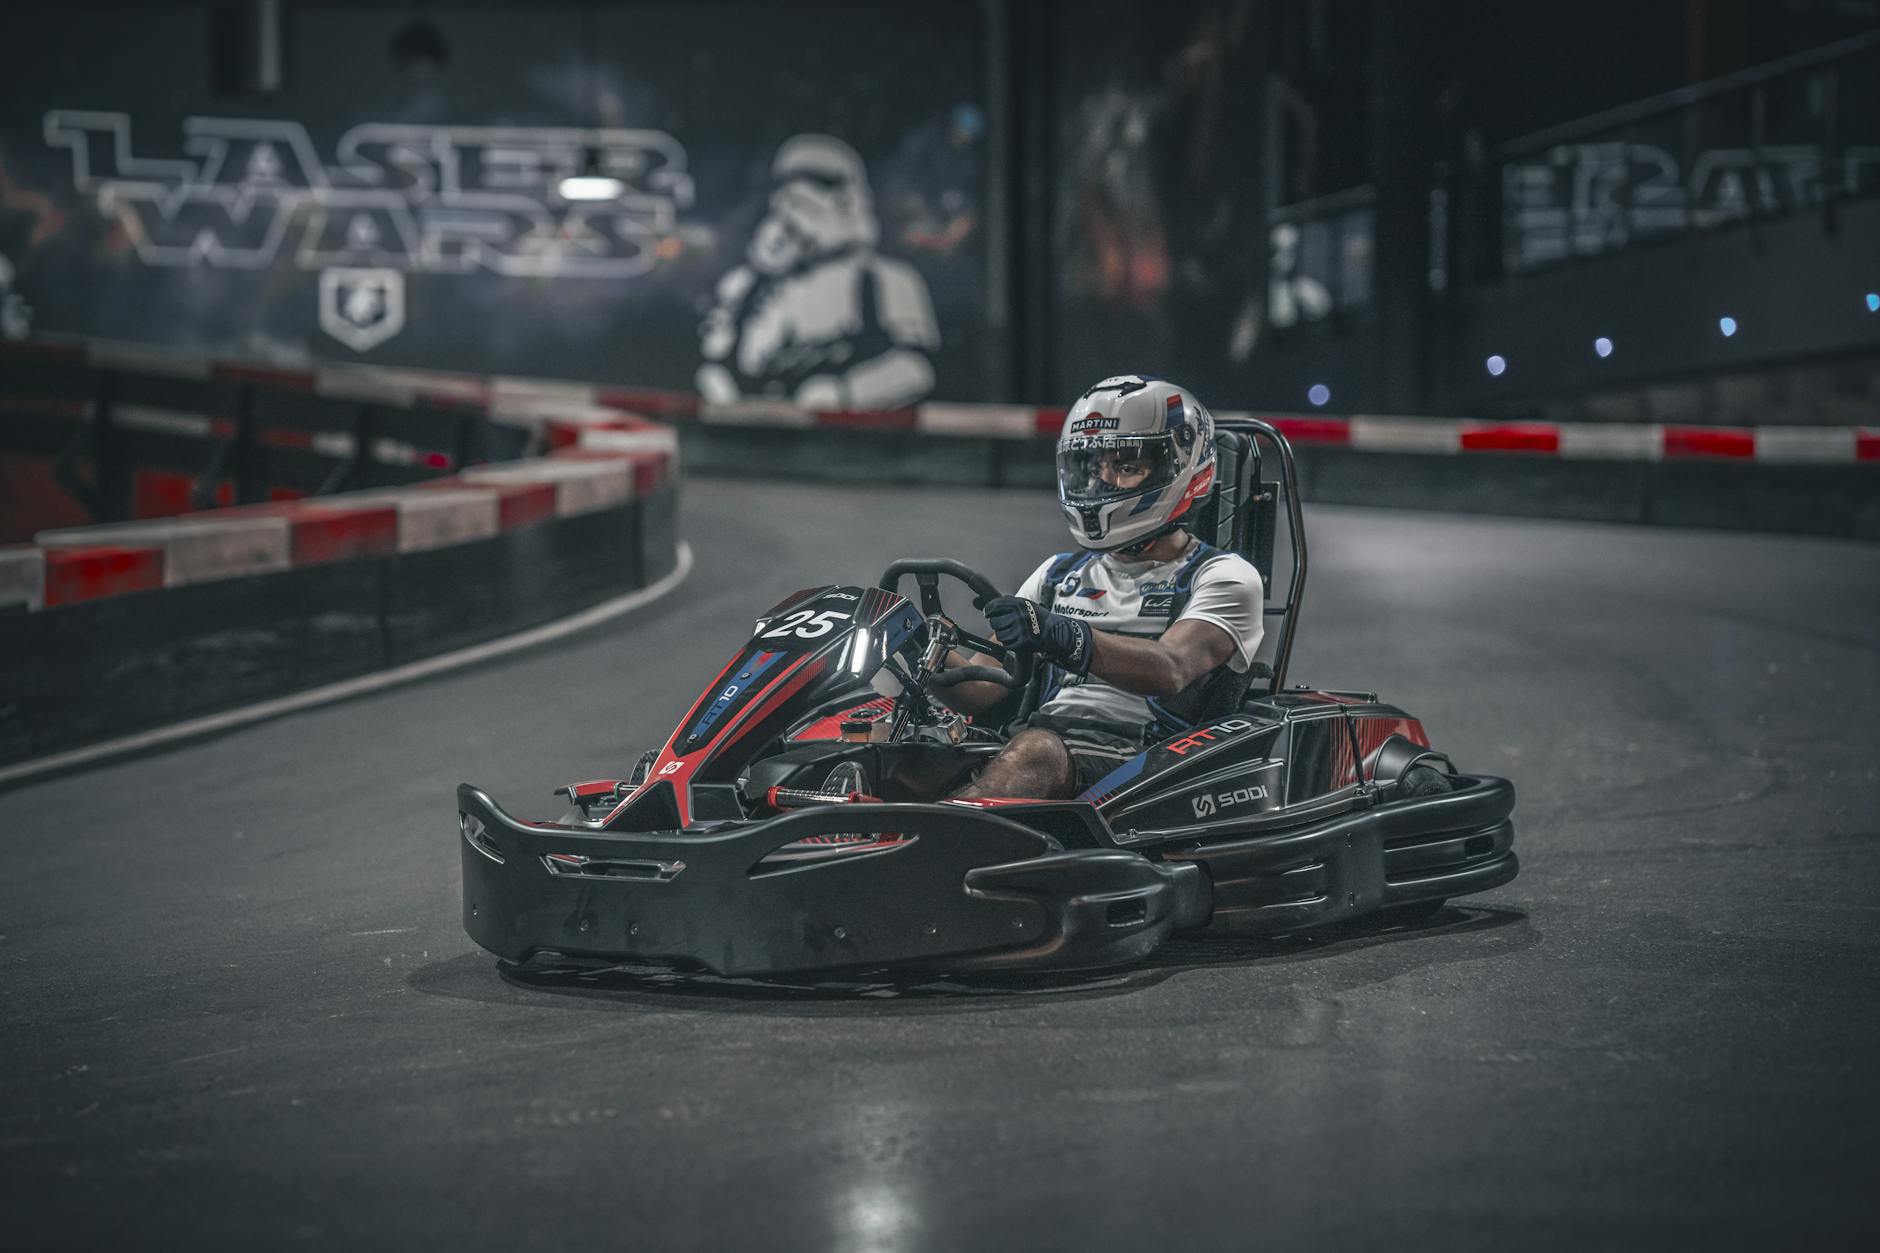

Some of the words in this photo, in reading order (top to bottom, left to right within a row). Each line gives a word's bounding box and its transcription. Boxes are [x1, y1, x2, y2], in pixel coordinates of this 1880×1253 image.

[44, 109, 694, 200] LASER
[97, 182, 676, 278] WARS
[1071, 418, 1118, 431] MARTINI
[760, 609, 851, 639] 25
[1053, 603, 1110, 618] Motorsport
[1166, 718, 1252, 756] RT10
[1217, 785, 1268, 808] SODI
